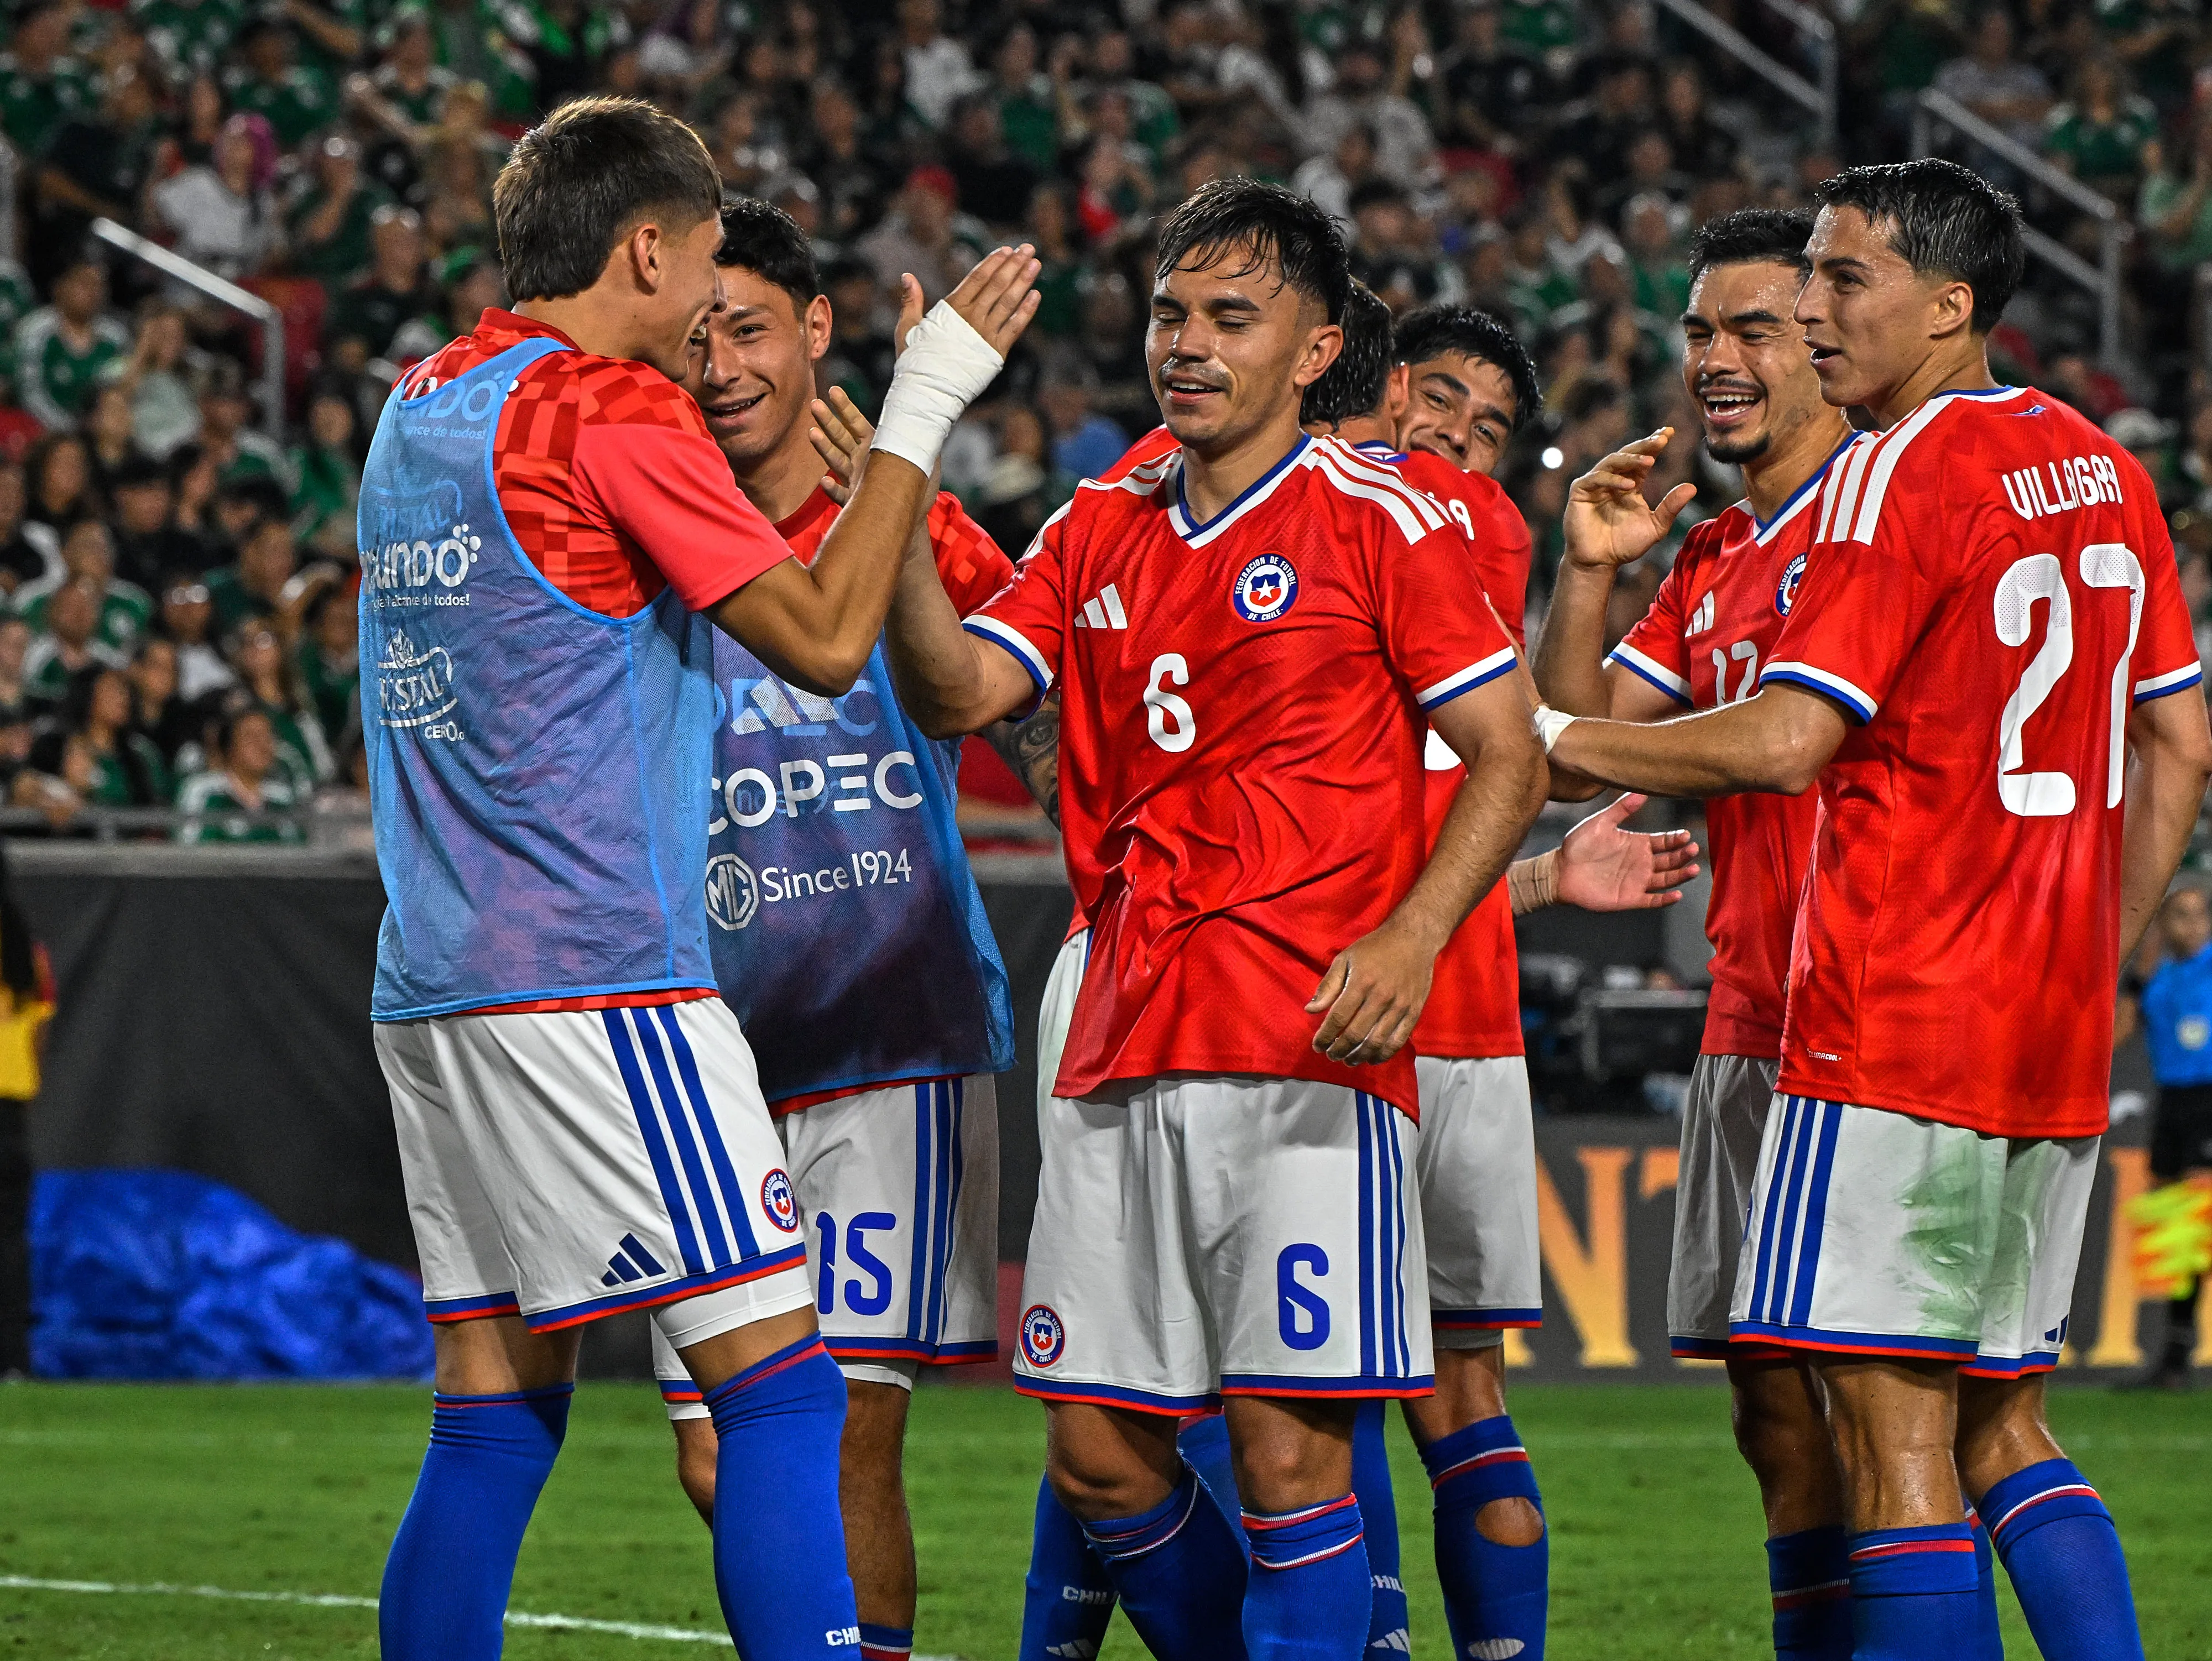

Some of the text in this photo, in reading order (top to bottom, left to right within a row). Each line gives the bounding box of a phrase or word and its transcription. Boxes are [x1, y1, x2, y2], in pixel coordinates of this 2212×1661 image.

[2002, 455, 2122, 520] VILLAGRA
[1235, 556, 1296, 594] FEDERACION DE FUTBOL
[1779, 555, 1804, 591] FEDERACION
[434, 593, 470, 606] todos!
[1247, 608, 1282, 621] DE CHILE
[1994, 542, 2146, 817] 27
[1143, 652, 1196, 753] 6
[707, 848, 912, 921] MG Since 1924
[816, 1211, 896, 1317] 15
[1277, 1242, 1331, 1351] 6
[1024, 1309, 1062, 1339] FEDERACION DE FUTBOL
[1031, 1352, 1038, 1360] DE
[1062, 1586, 1118, 1605] CHIL
